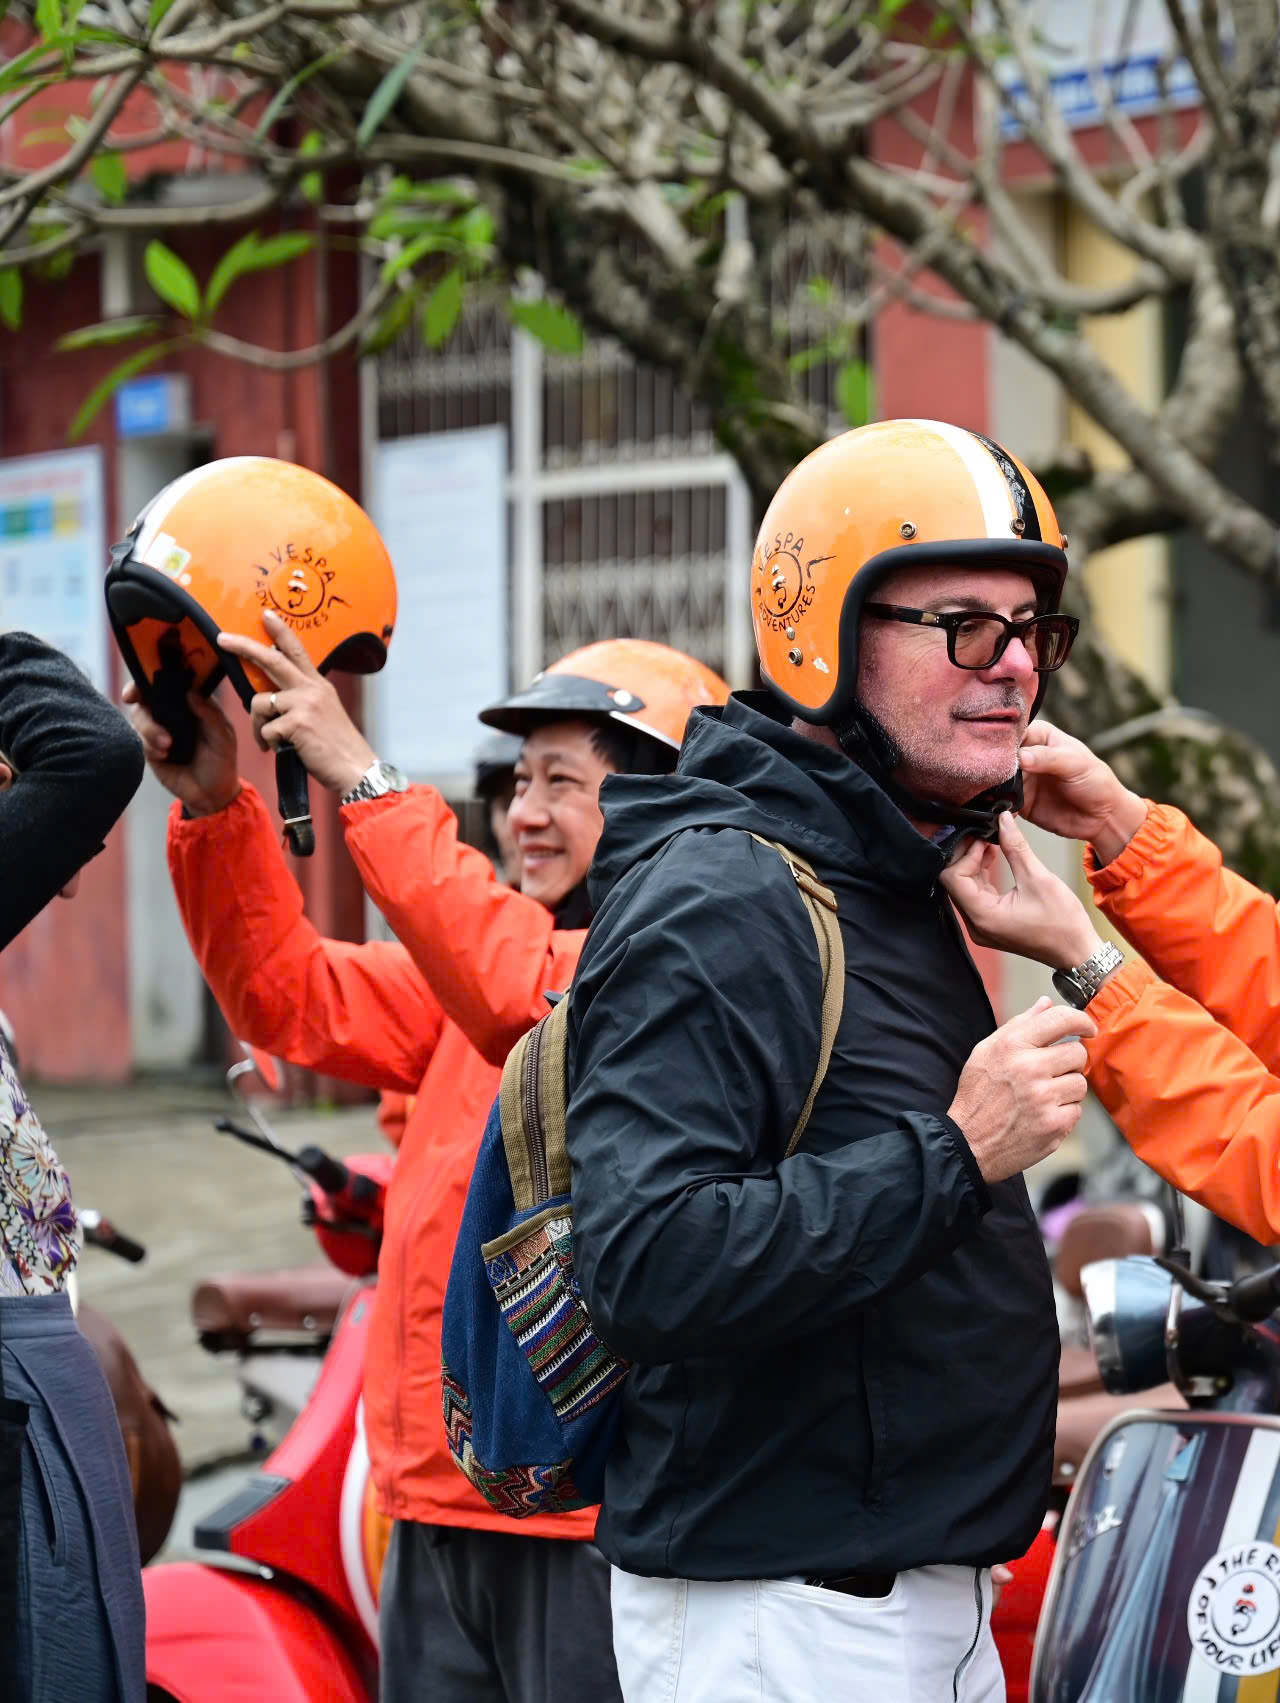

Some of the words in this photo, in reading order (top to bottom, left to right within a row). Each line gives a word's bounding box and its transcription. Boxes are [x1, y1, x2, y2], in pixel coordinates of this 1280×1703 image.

[269, 543, 336, 583] VESPA
[256, 580, 329, 631] ADVTURES
[758, 584, 816, 632] ADVENTURES
[1218, 1548, 1259, 1575] THE
[1197, 1629, 1244, 1670] YOUR
